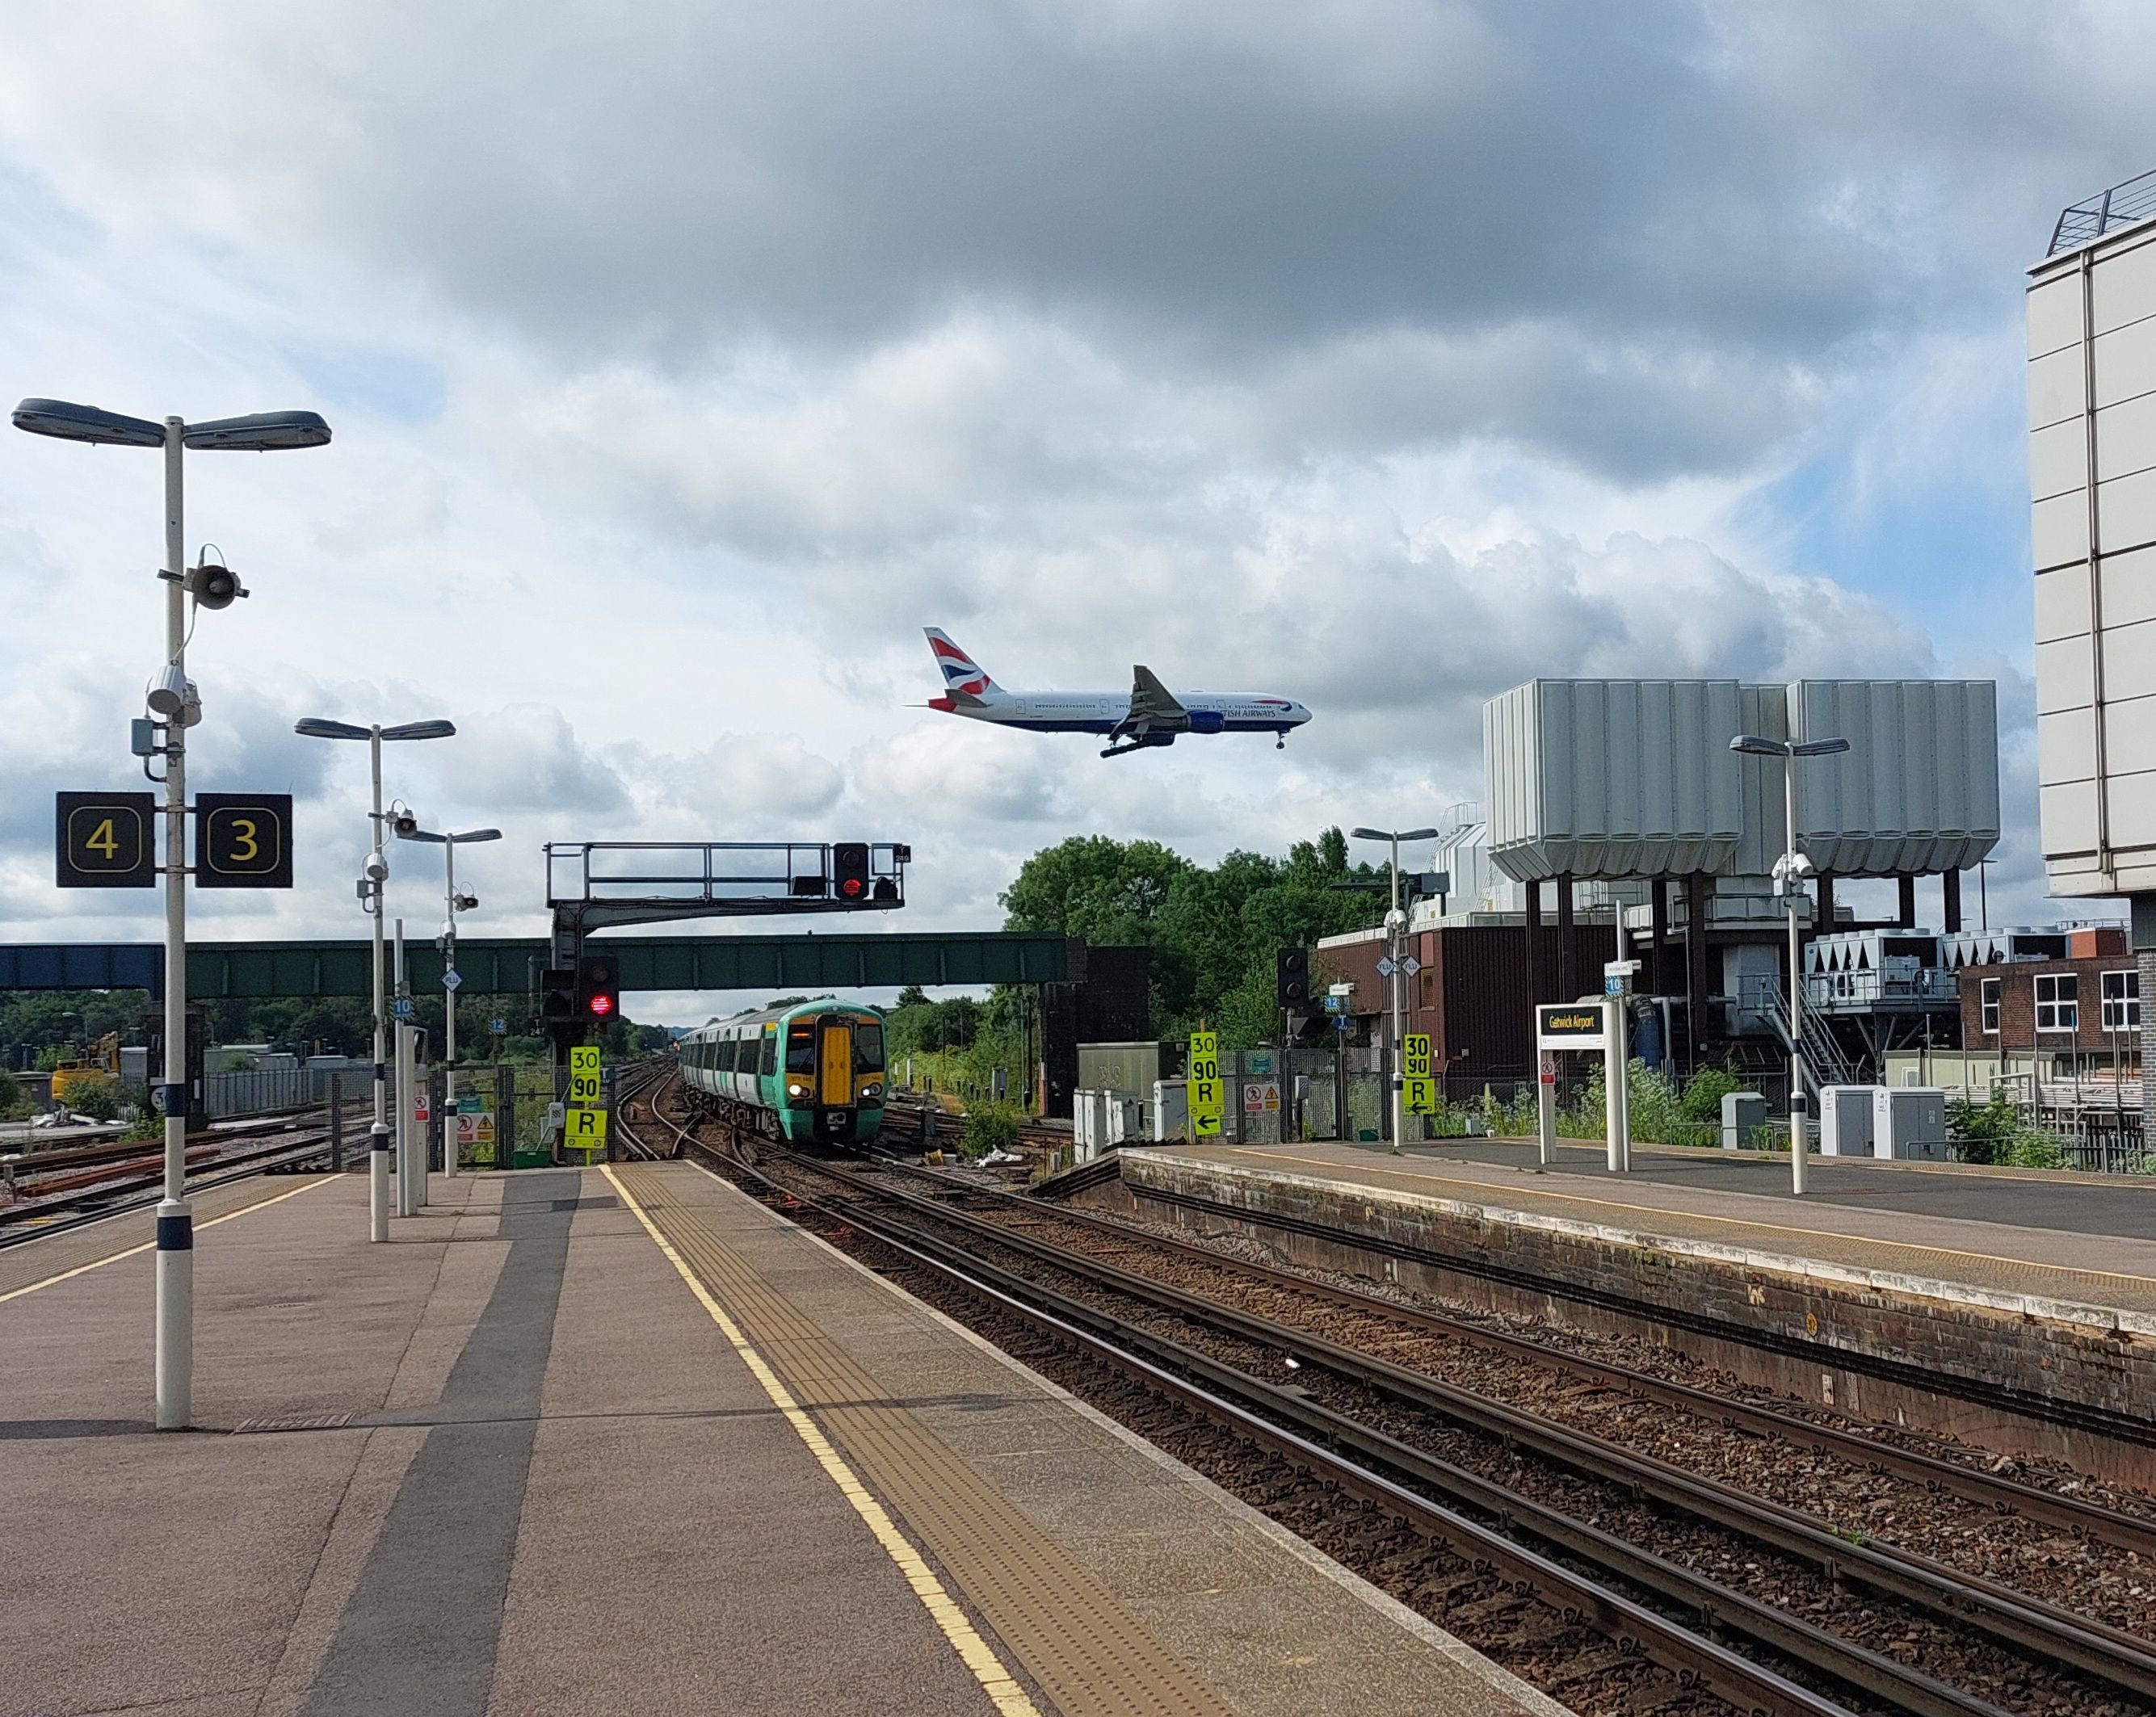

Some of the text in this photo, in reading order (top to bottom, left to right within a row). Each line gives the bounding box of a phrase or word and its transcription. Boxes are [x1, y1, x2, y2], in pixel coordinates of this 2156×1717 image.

[1242, 710, 1276, 718] AIRWAYS
[86, 819, 119, 859] 4
[229, 820, 258, 861] 3
[1608, 978, 1621, 990] 10
[393, 999, 411, 1013] 10
[1327, 997, 1338, 1007] 12
[492, 1018, 505, 1030] 12
[1339, 1015, 1347, 1026] T
[1549, 1014, 1595, 1031] Gatwick Airport
[530, 1027, 545, 1035] 247
[1192, 1037, 1215, 1052] 30
[1407, 1037, 1428, 1056] 30
[574, 1052, 598, 1068] 30
[1408, 1059, 1427, 1074] 90
[1193, 1060, 1217, 1081] 90
[574, 1078, 597, 1097] 90
[1198, 1082, 1212, 1102] R
[1412, 1081, 1425, 1102] R
[578, 1112, 596, 1134] R
